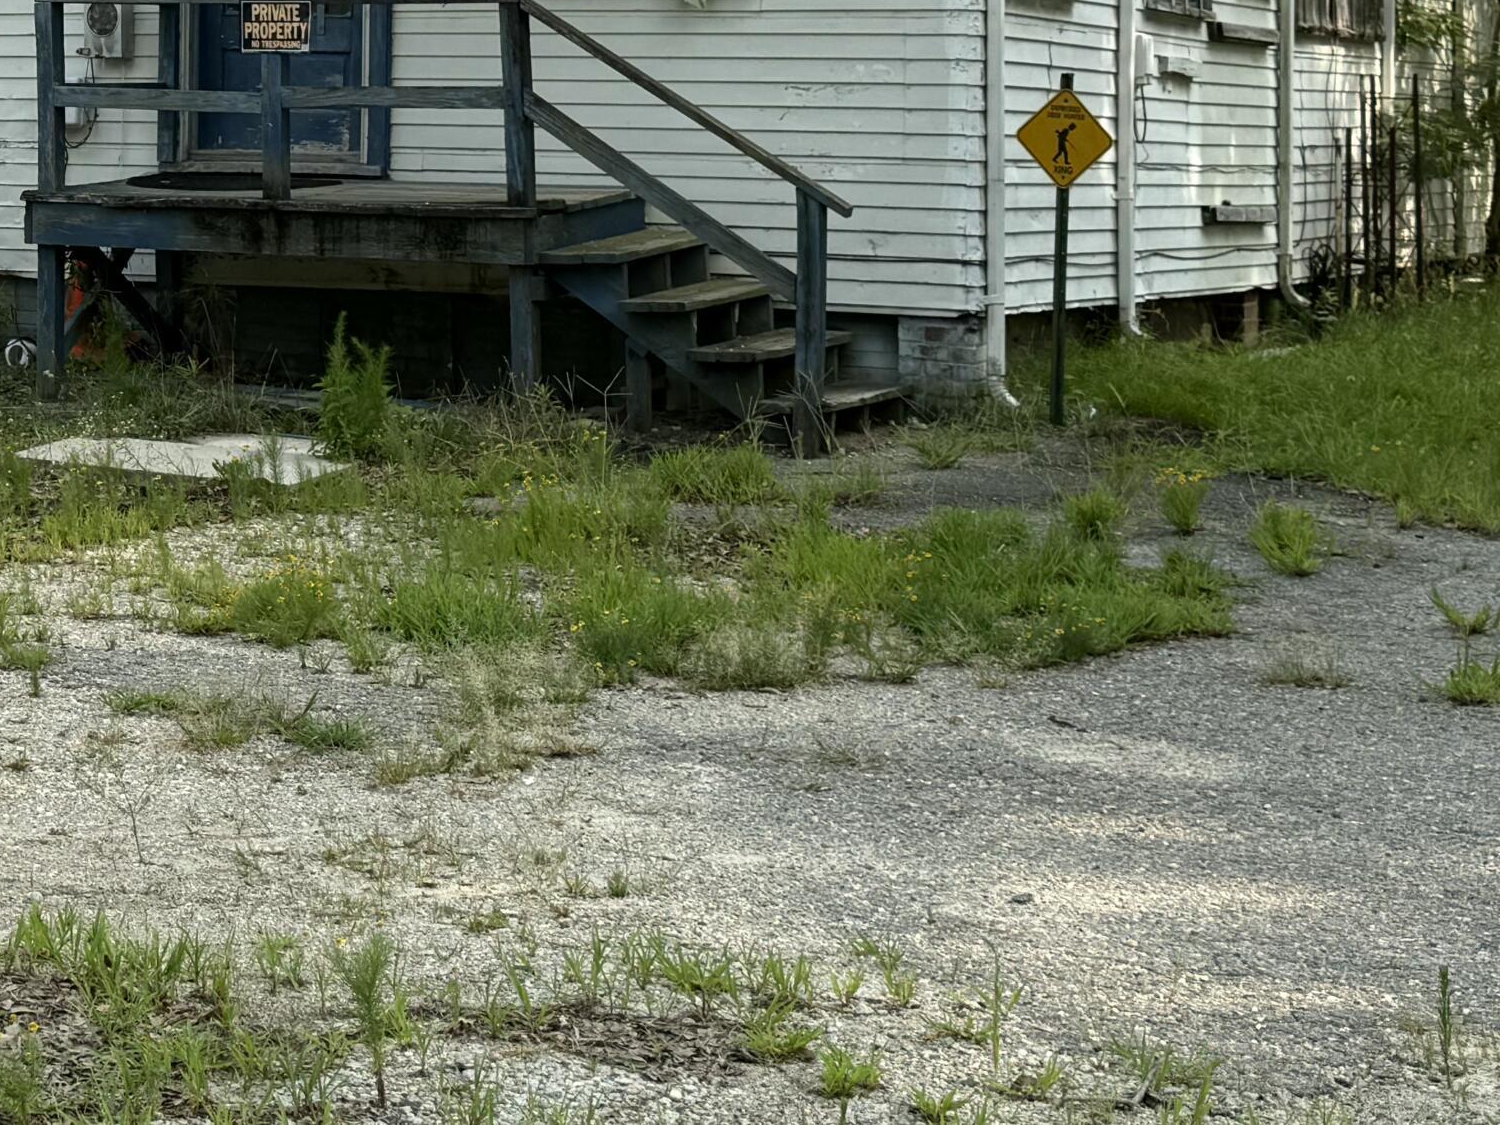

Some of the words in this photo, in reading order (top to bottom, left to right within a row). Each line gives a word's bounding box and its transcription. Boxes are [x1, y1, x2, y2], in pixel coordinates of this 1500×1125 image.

[251, 3, 301, 21] PRIVATE
[244, 22, 307, 39] PROPERTY
[251, 40, 260, 48] NO
[261, 40, 301, 49] TRESPASSING
